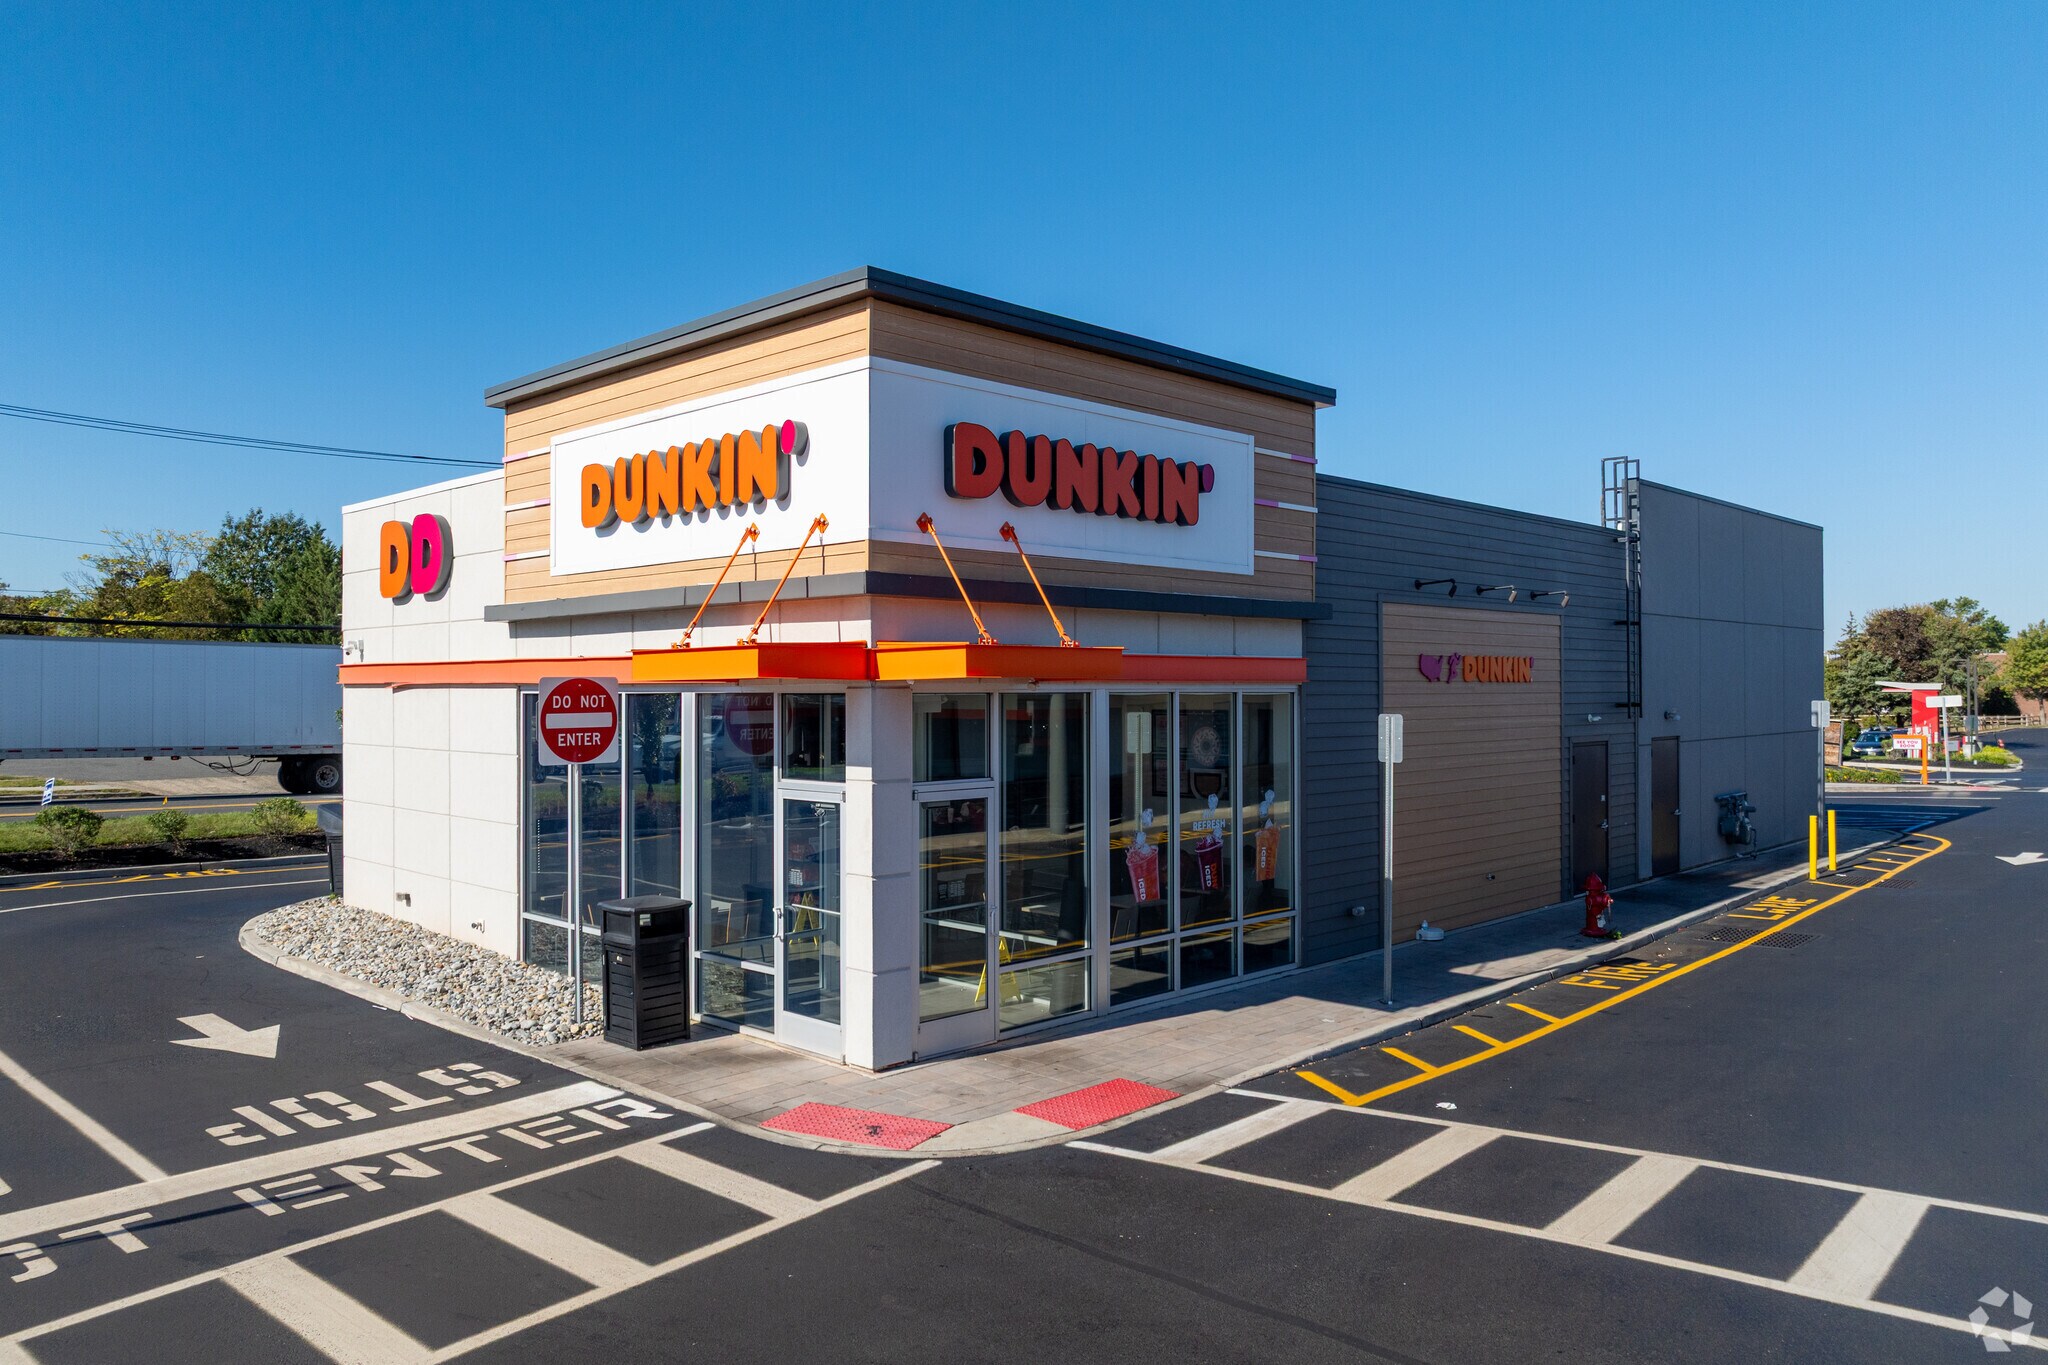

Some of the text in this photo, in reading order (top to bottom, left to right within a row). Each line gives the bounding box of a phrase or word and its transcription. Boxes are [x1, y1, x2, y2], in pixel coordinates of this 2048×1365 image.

[581, 419, 804, 529] DUNKIN'
[945, 421, 1215, 527] DUNKIN'
[380, 513, 449, 599] DD
[1462, 655, 1534, 683] DUNKIN'
[552, 694, 607, 709] DO NOT
[557, 732, 602, 747] ENTER
[1192, 818, 1226, 831] REFRESH
[1137, 877, 1146, 901] ICED
[1204, 864, 1212, 887] ICED
[1559, 962, 1678, 989] FIRE
[205, 1062, 522, 1147] STOP
[232, 1097, 674, 1217] ENTER
